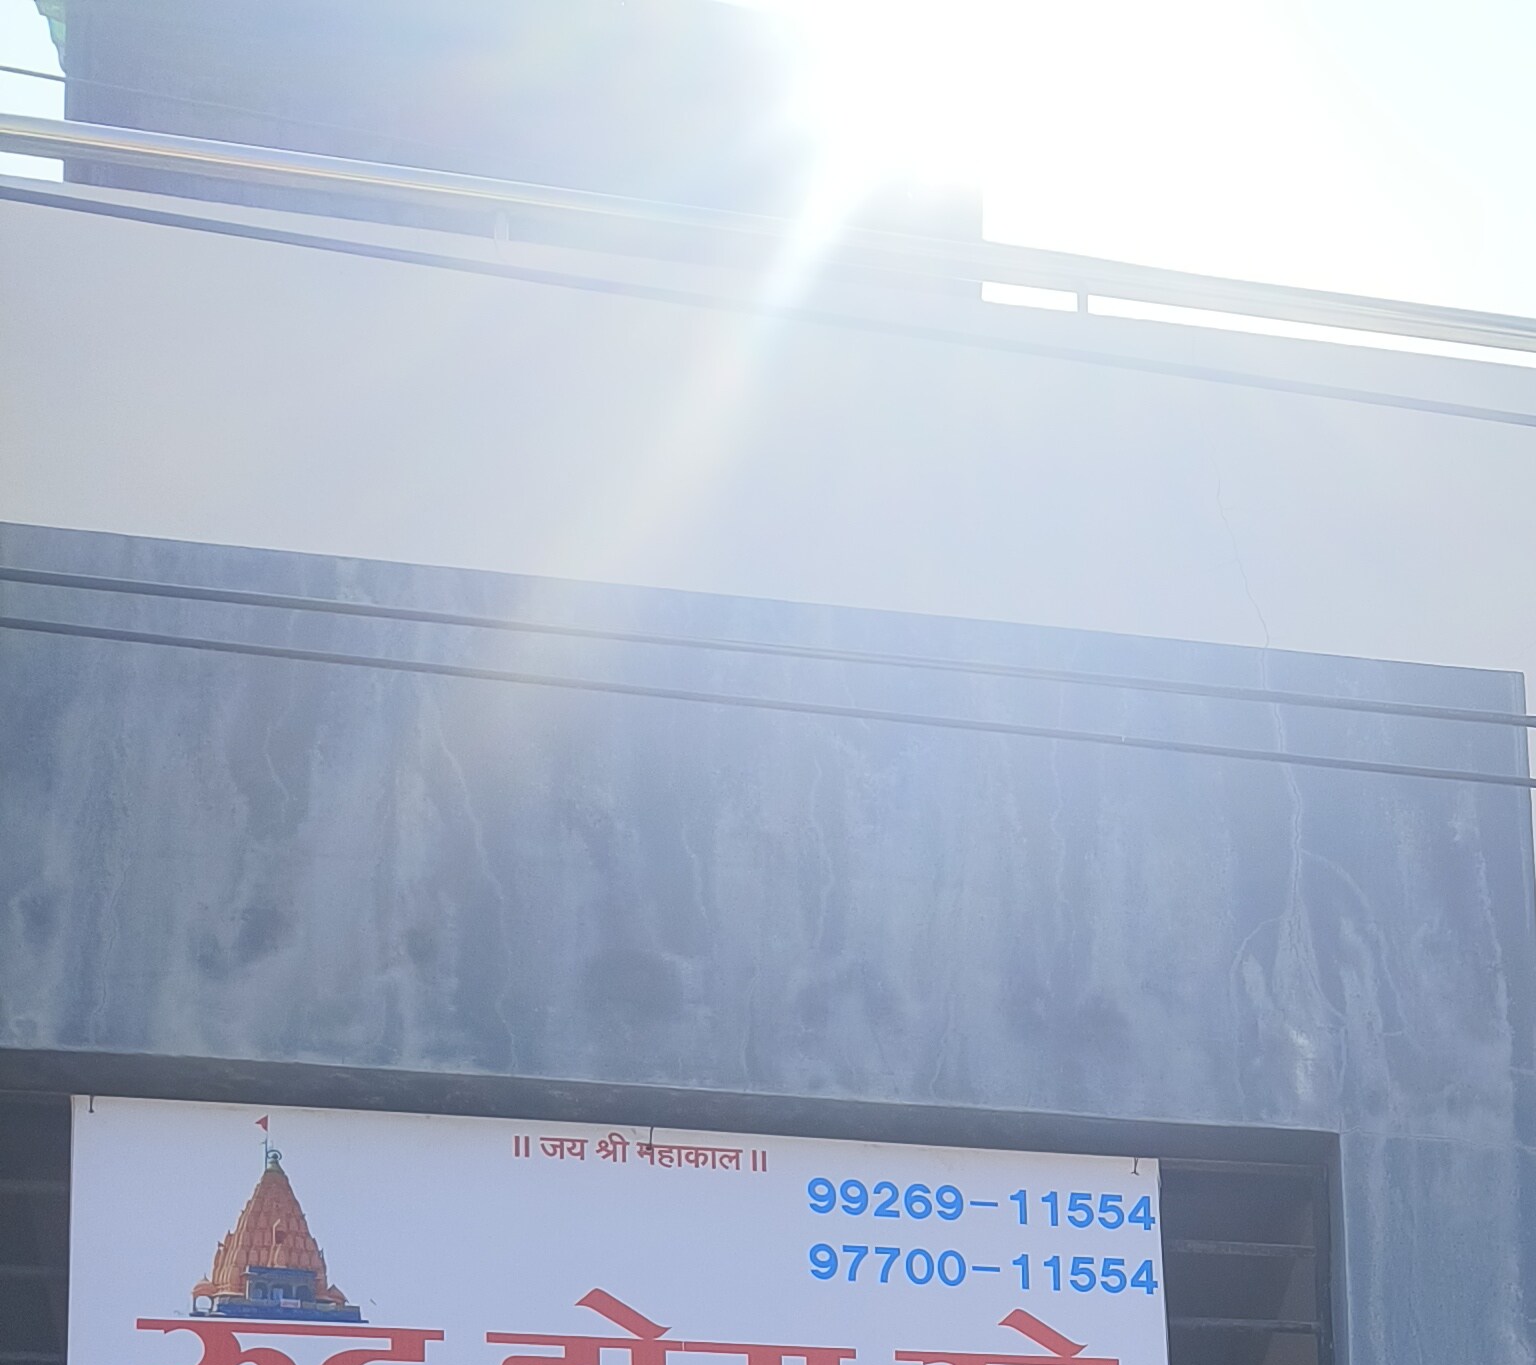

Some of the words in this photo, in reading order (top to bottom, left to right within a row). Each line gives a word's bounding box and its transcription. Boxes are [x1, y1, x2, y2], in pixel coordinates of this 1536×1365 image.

[540, 1135, 588, 1162] जय
[595, 1132, 630, 1163] श्री
[636, 1143, 743, 1171] महाकाल
[807, 1177, 1156, 1231] 99269-11554
[809, 1243, 1158, 1295] 97700-11554
